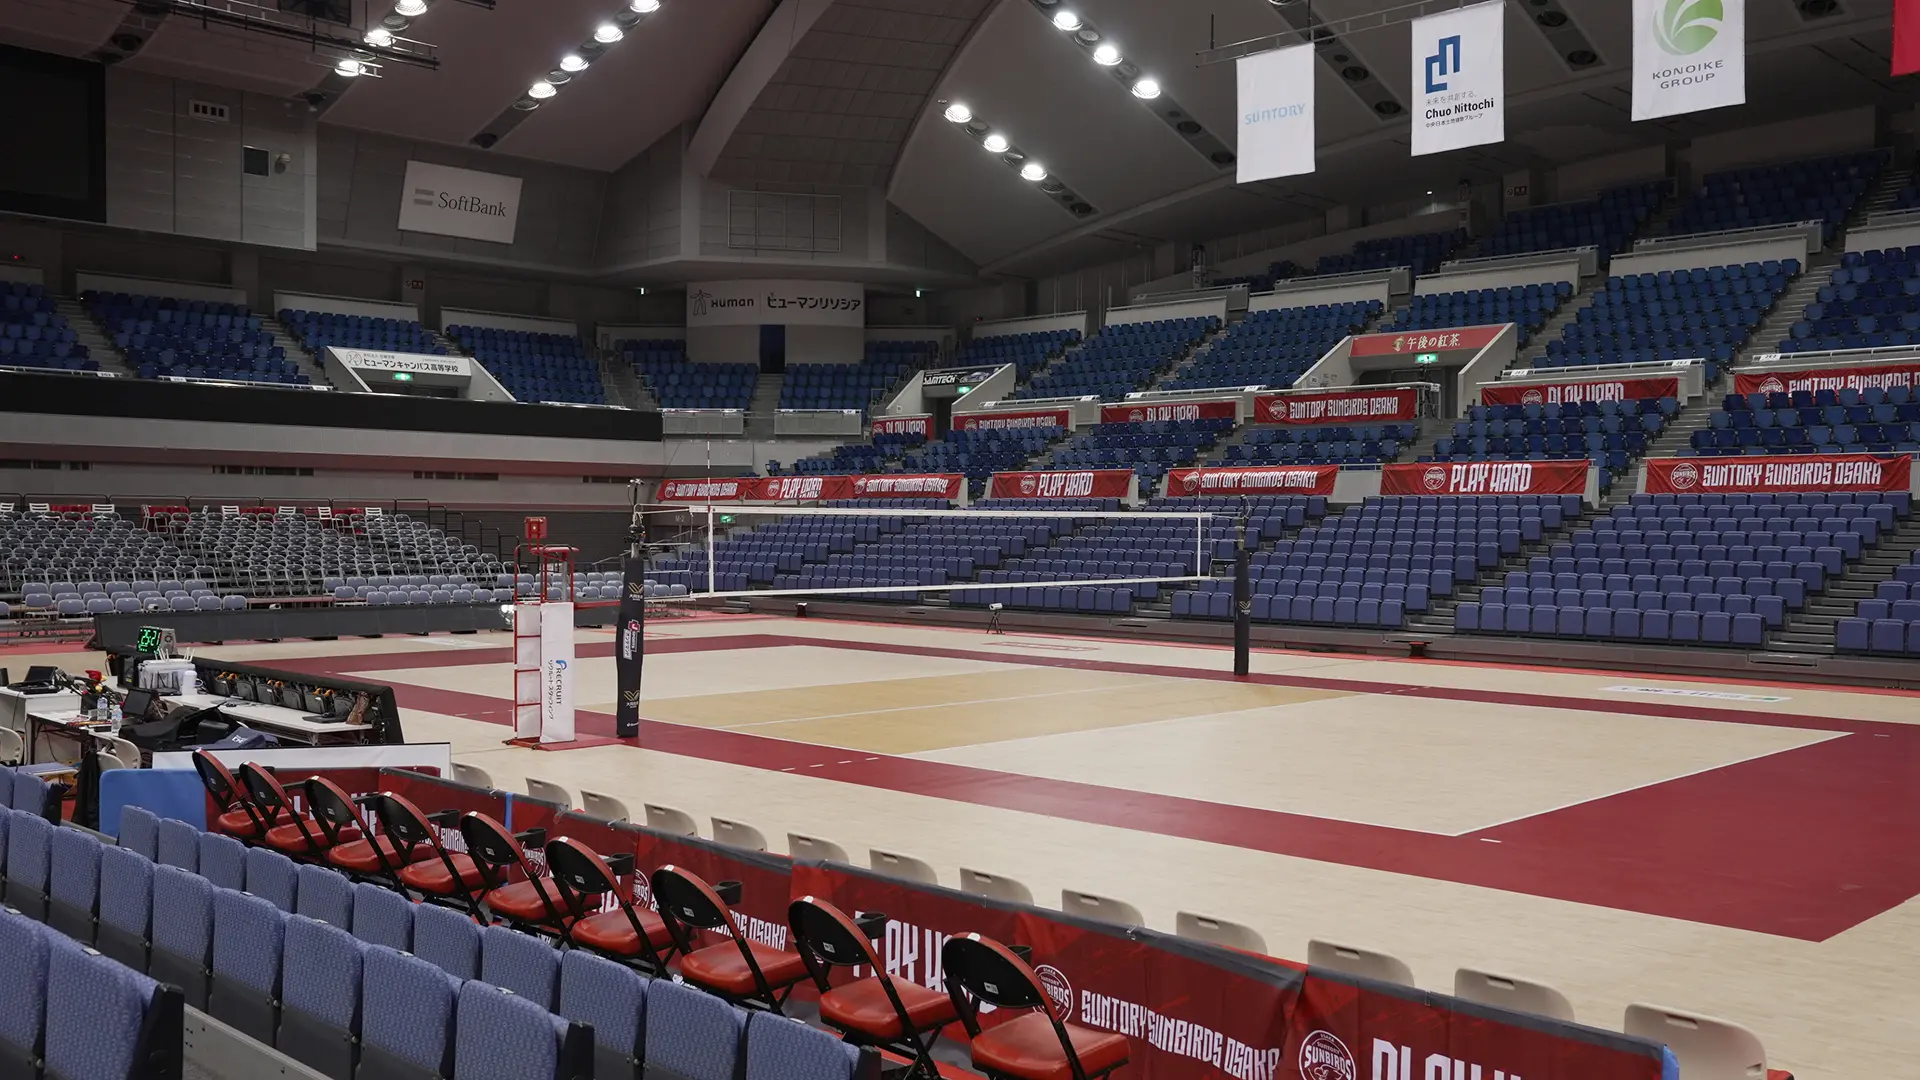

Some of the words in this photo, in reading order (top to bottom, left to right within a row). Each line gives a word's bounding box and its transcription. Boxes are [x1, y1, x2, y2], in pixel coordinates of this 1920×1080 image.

[1652, 59, 1723, 79] KONOIKE
[1660, 73, 1716, 89] GROUP
[1244, 103, 1306, 125] SUNTORY
[1425, 108, 1452, 119] Chuo
[1454, 97, 1494, 114] Nittochi
[438, 191, 507, 217] SoftBank
[711, 298, 754, 308] Human
[1406, 333, 1460, 350] 午後の紅茶
[1290, 400, 1327, 419] SUNTORY
[1327, 398, 1368, 417] SUNBIRDS
[1369, 397, 1398, 415] OSAKA
[1037, 473, 1066, 496] PLAY
[1064, 472, 1094, 496] HARD
[1201, 472, 1241, 489] SUNTORY
[1241, 471, 1285, 488] SUNBIRDS
[1285, 471, 1318, 488] OSAKA
[1450, 464, 1490, 493] PLAY
[1489, 463, 1533, 492] HARD
[1702, 464, 1762, 487] SUNTORY
[1764, 463, 1833, 486] SUNBIRDS
[1834, 462, 1882, 485] OSAKA
[780, 478, 801, 498] PLAY
[749, 916, 788, 951] OSAKA
[1081, 989, 1147, 1039] SUNTORY
[1148, 1010, 1223, 1068] SUNBIRDS
[1303, 1044, 1352, 1080] SUNBIRDS
